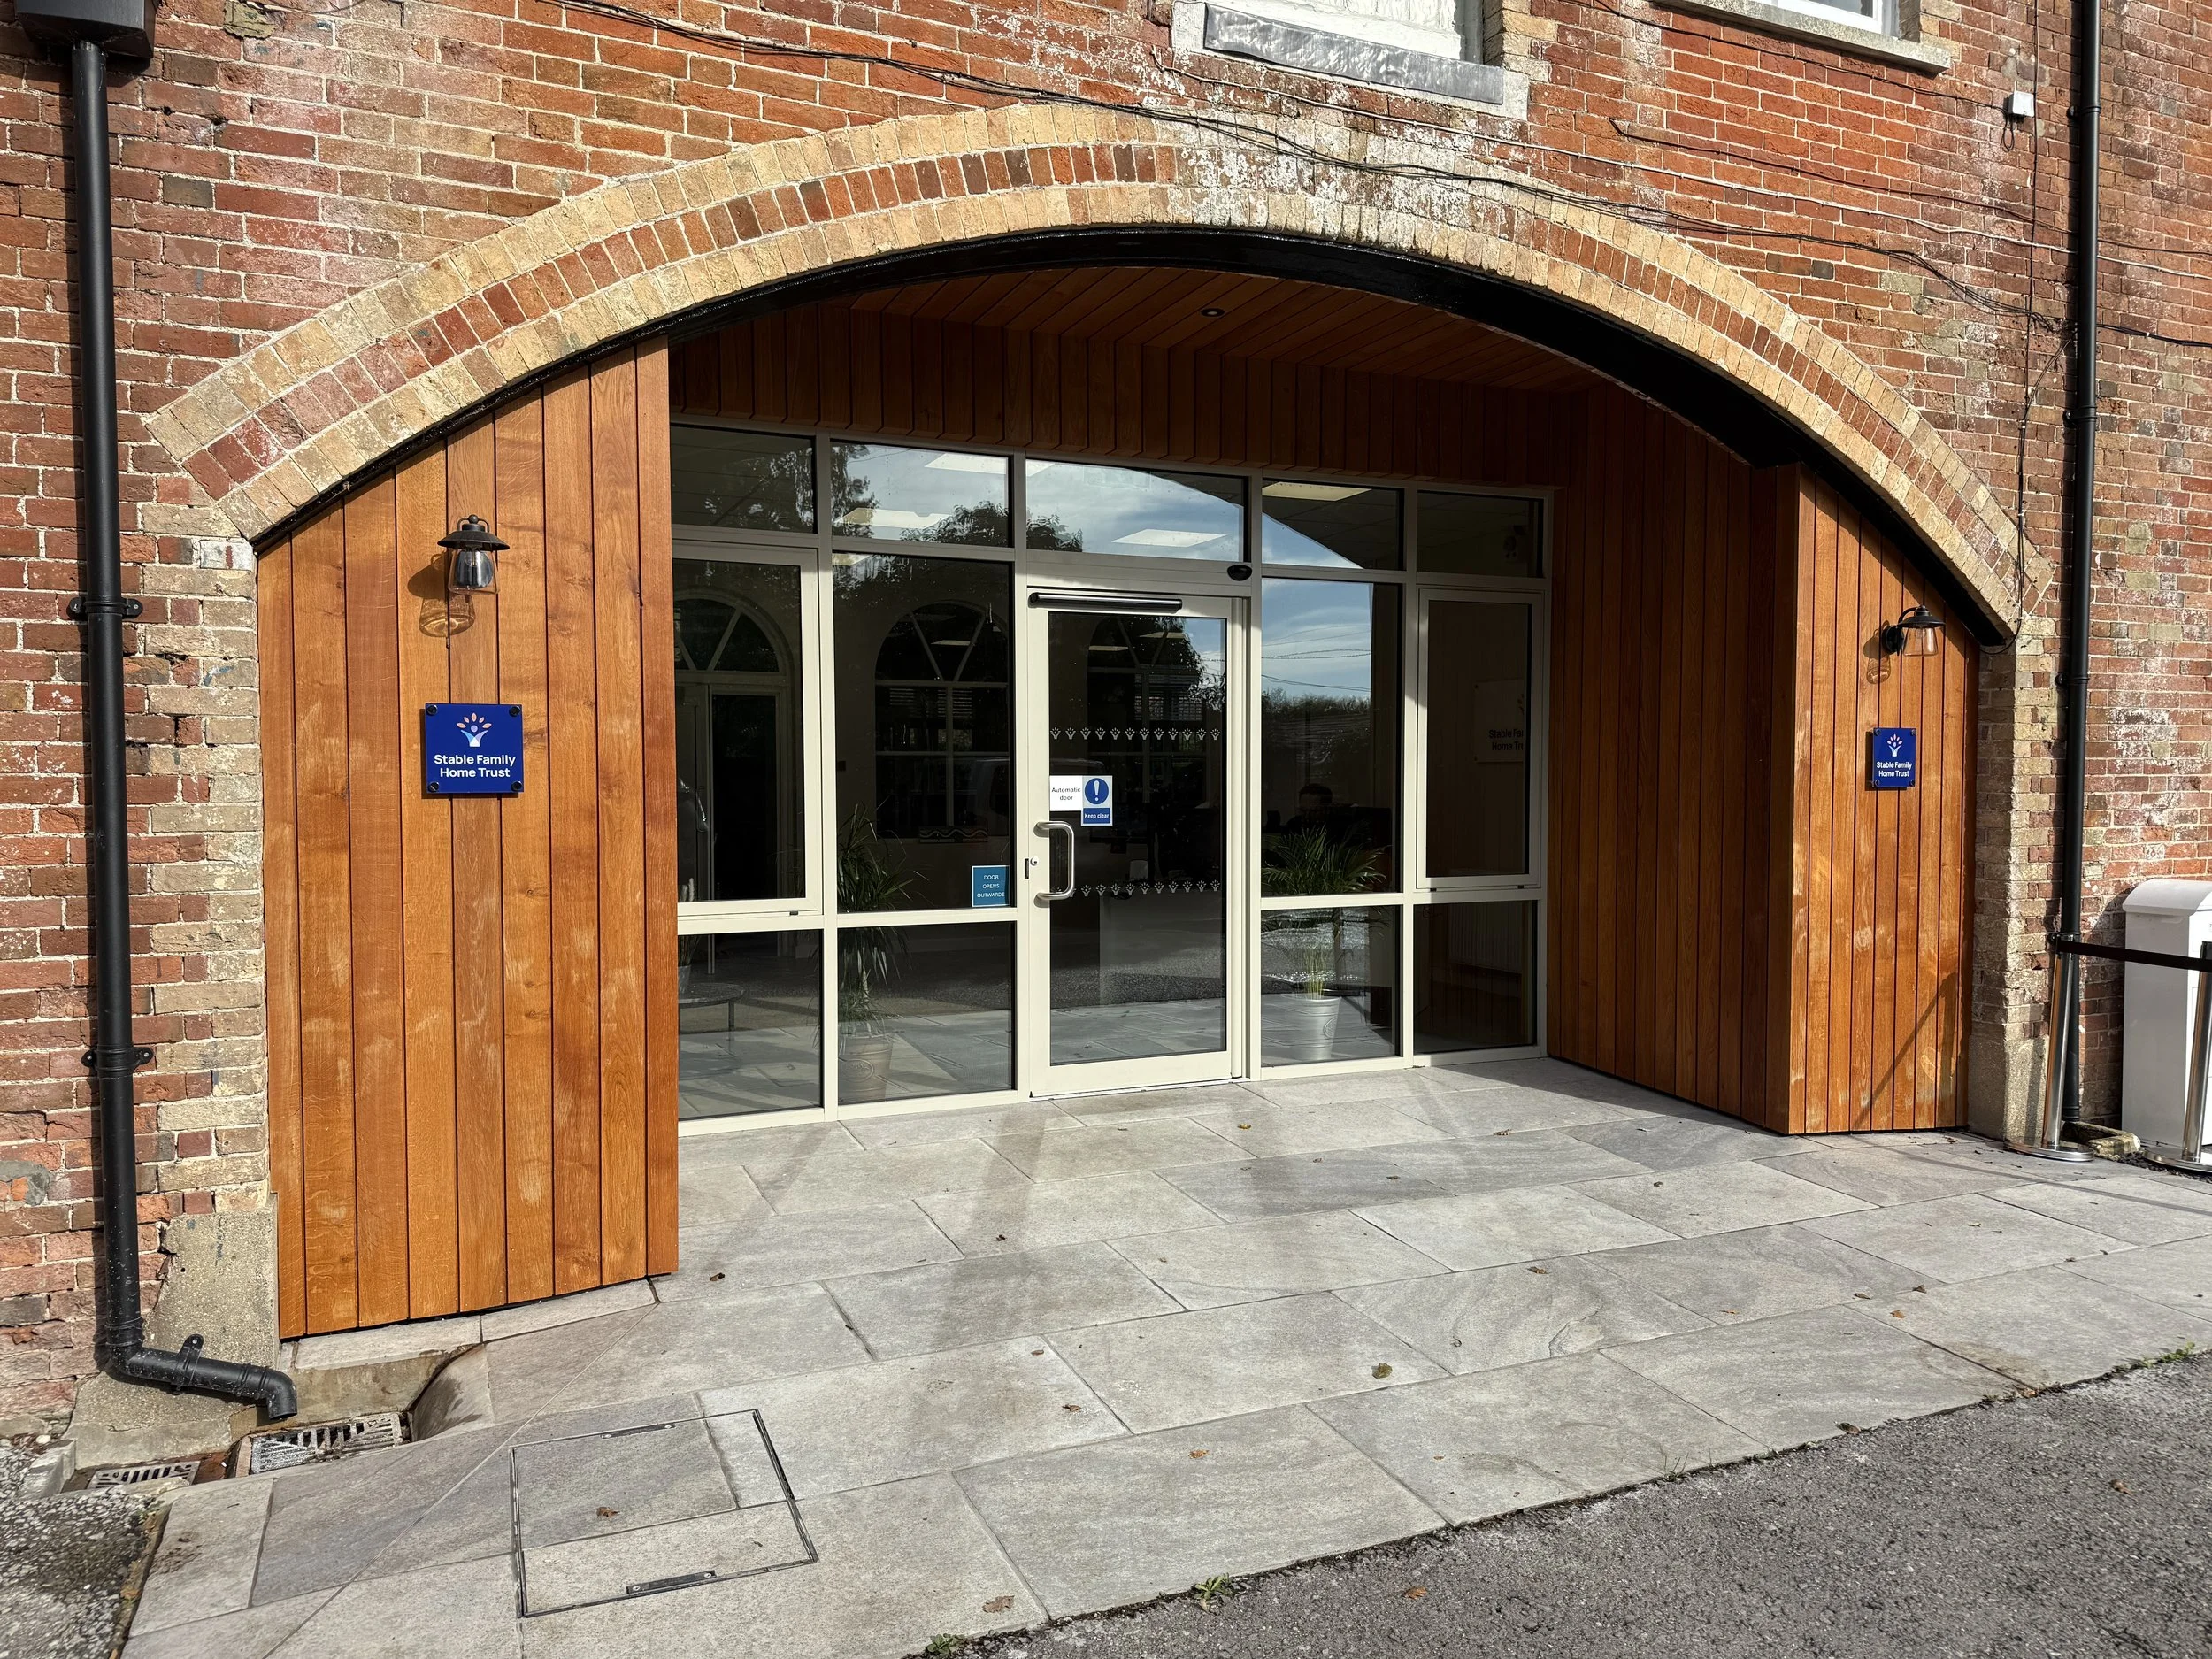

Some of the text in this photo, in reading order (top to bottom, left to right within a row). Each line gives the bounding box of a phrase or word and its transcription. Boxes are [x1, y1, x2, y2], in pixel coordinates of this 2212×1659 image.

[1488, 728, 1513, 739] Stable
[1492, 741, 1513, 751] Home
[434, 754, 516, 767] Stable Family
[1894, 761, 1912, 771] Family
[440, 767, 511, 778] Home Trust
